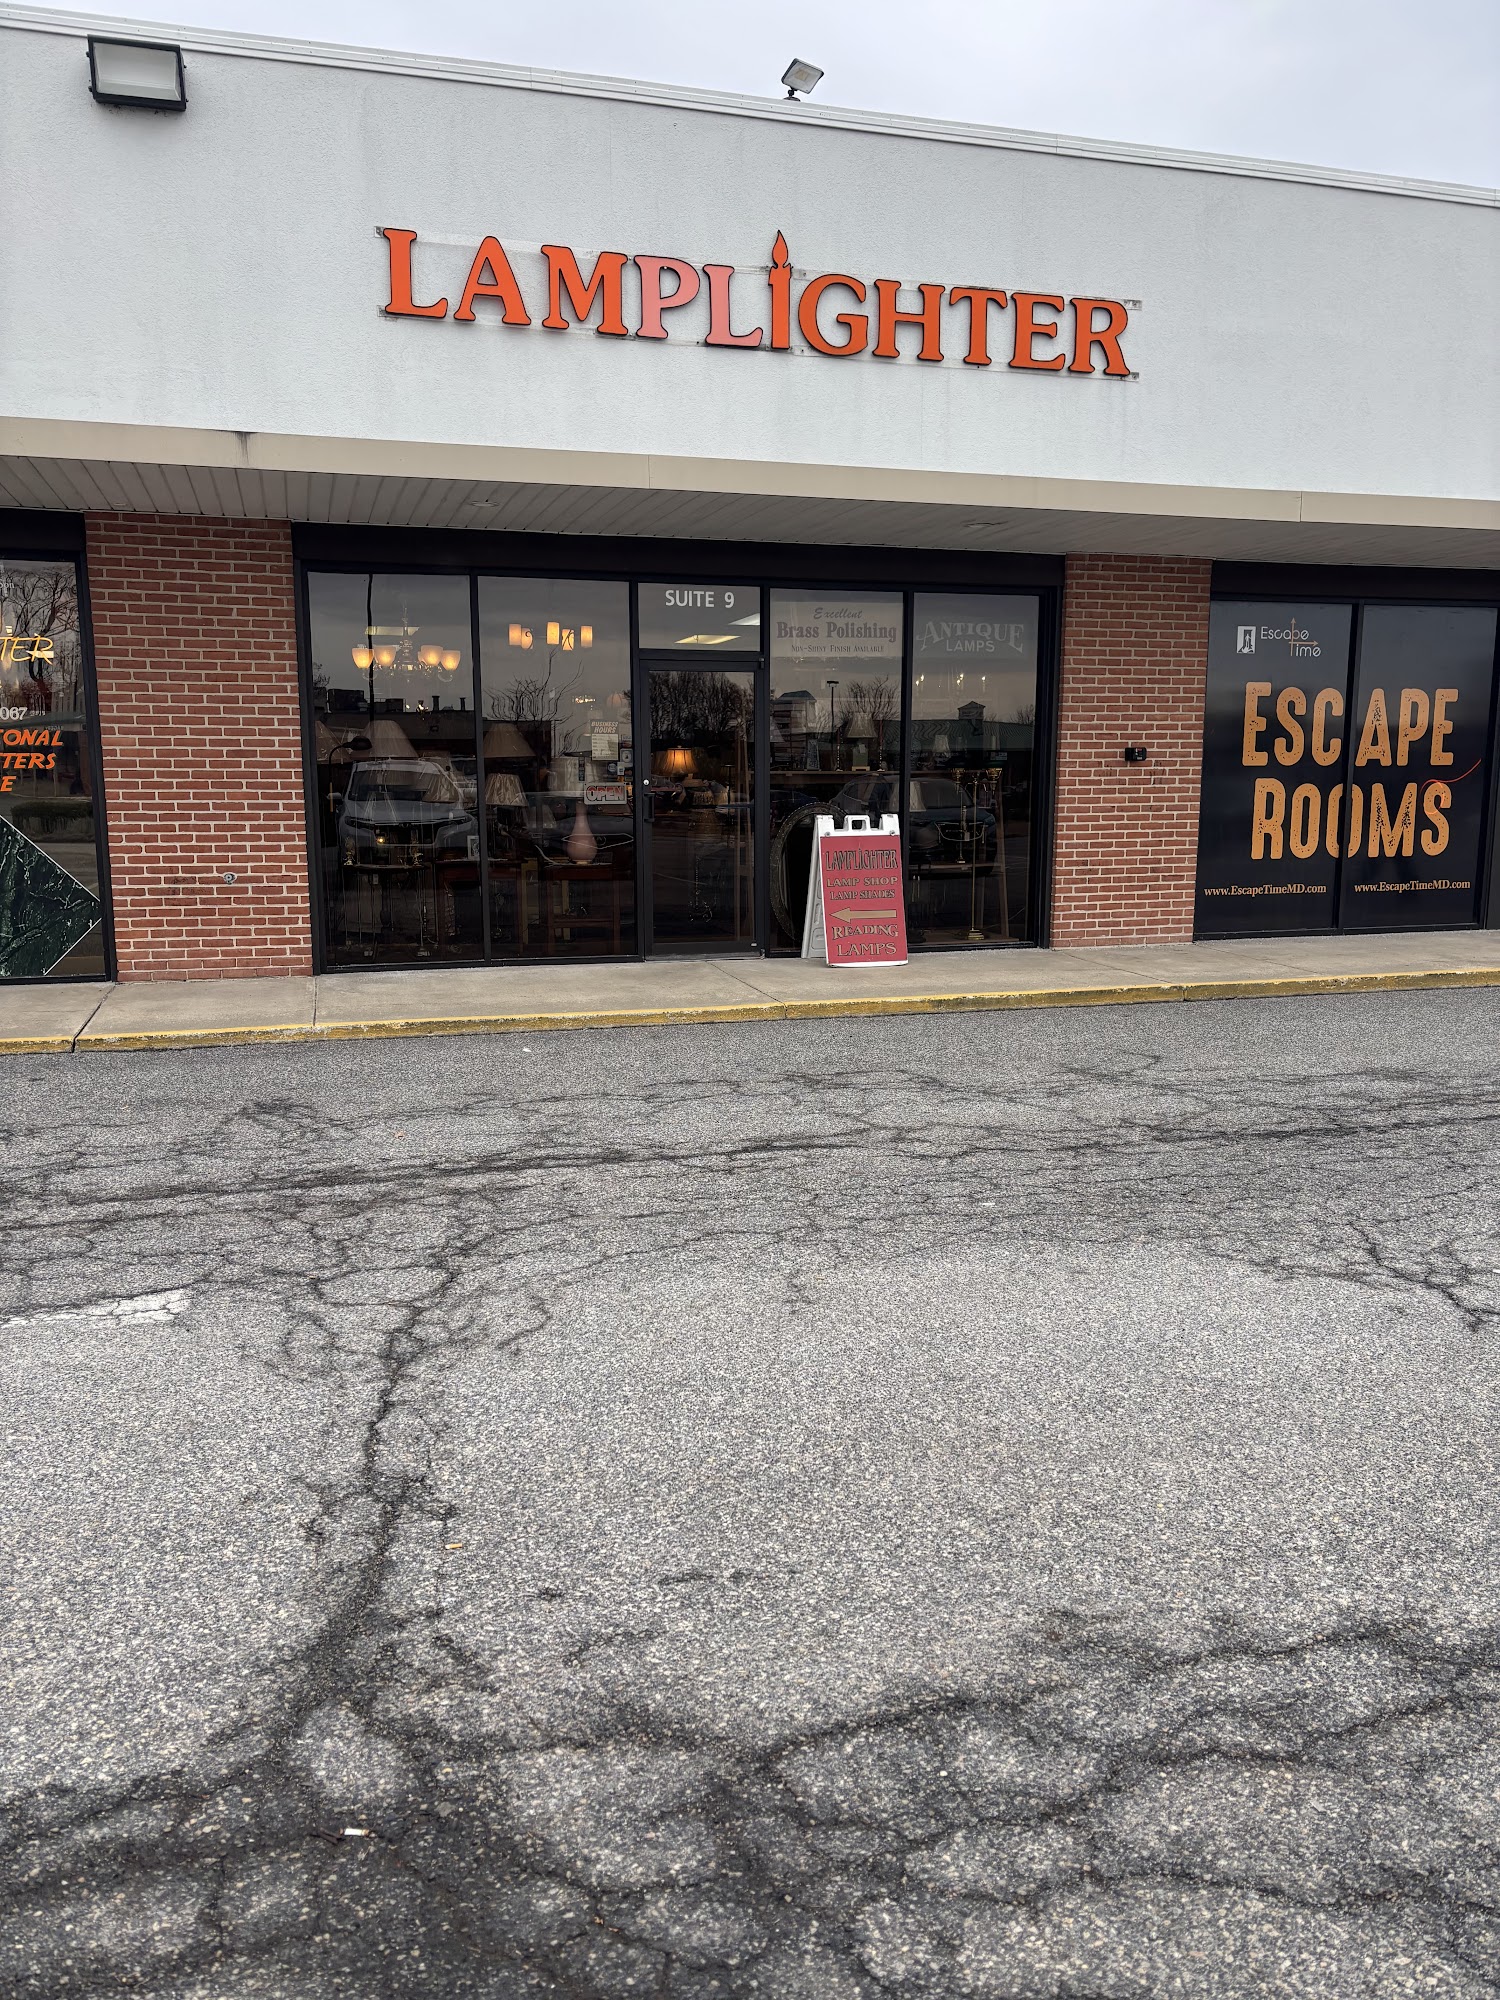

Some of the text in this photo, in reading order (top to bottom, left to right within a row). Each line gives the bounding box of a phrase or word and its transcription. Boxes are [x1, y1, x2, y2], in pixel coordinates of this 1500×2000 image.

[382, 230, 1131, 376] LAMPLIGHTER
[665, 589, 735, 609] SUITE 9
[813, 607, 863, 620] Excellent
[776, 621, 897, 643] Brass Polishing
[915, 621, 1024, 653] ANTIQUE
[1260, 625, 1310, 641] Escape
[946, 640, 995, 653] LAMPS
[1288, 640, 1322, 657] Time
[0, 706, 28, 720] 067
[1242, 682, 1459, 767] ESCAPE
[0, 728, 64, 746] ONAL
[0, 752, 56, 769] TERS
[586, 786, 624, 801] OPEN
[1251, 778, 1452, 860] ROOMS
[827, 877, 898, 887] LAMP SHOP
[1203, 883, 1327, 897] www.EscapeTimeMD.com
[1354, 880, 1471, 893] www.EscapeTimeMD.com
[830, 890, 895, 900] LAMP SHADES
[832, 924, 899, 941] READING
[838, 942, 897, 956] LAMPS
